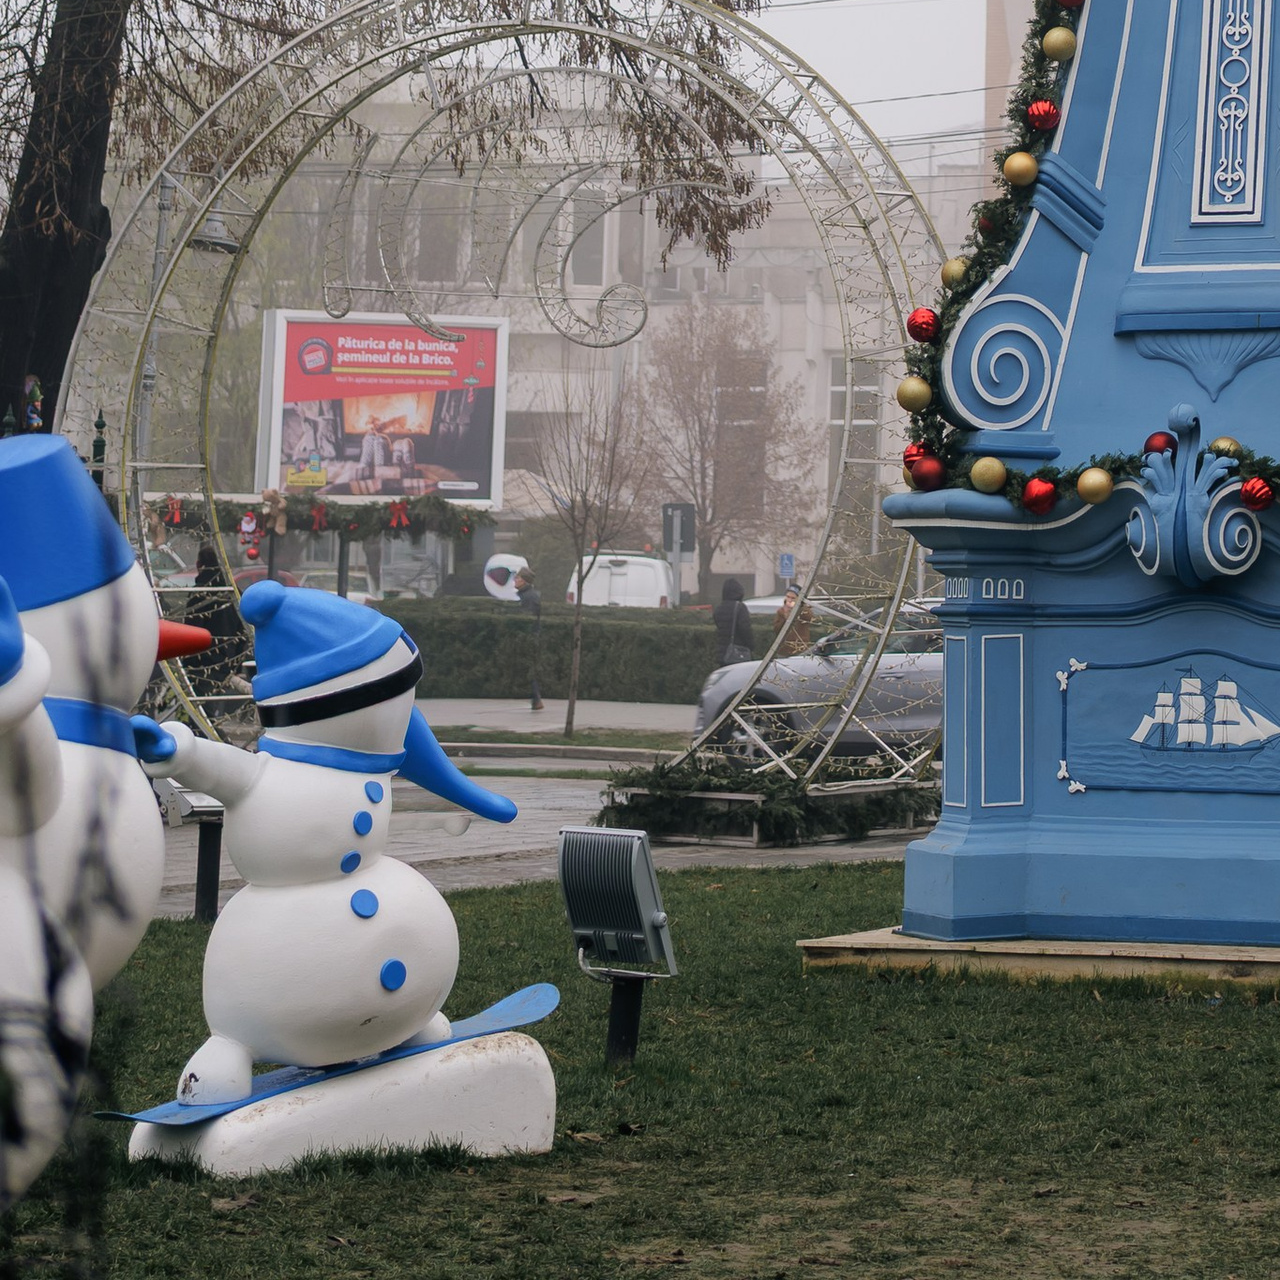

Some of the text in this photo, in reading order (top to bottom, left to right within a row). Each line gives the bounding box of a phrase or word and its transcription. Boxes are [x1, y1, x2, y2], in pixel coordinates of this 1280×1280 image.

[338, 337, 458, 353] Păturica de la bunica,
[337, 351, 390, 363] șemineul
[392, 353, 406, 363] de
[409, 353, 419, 363] la
[422, 354, 453, 365] Brico.
